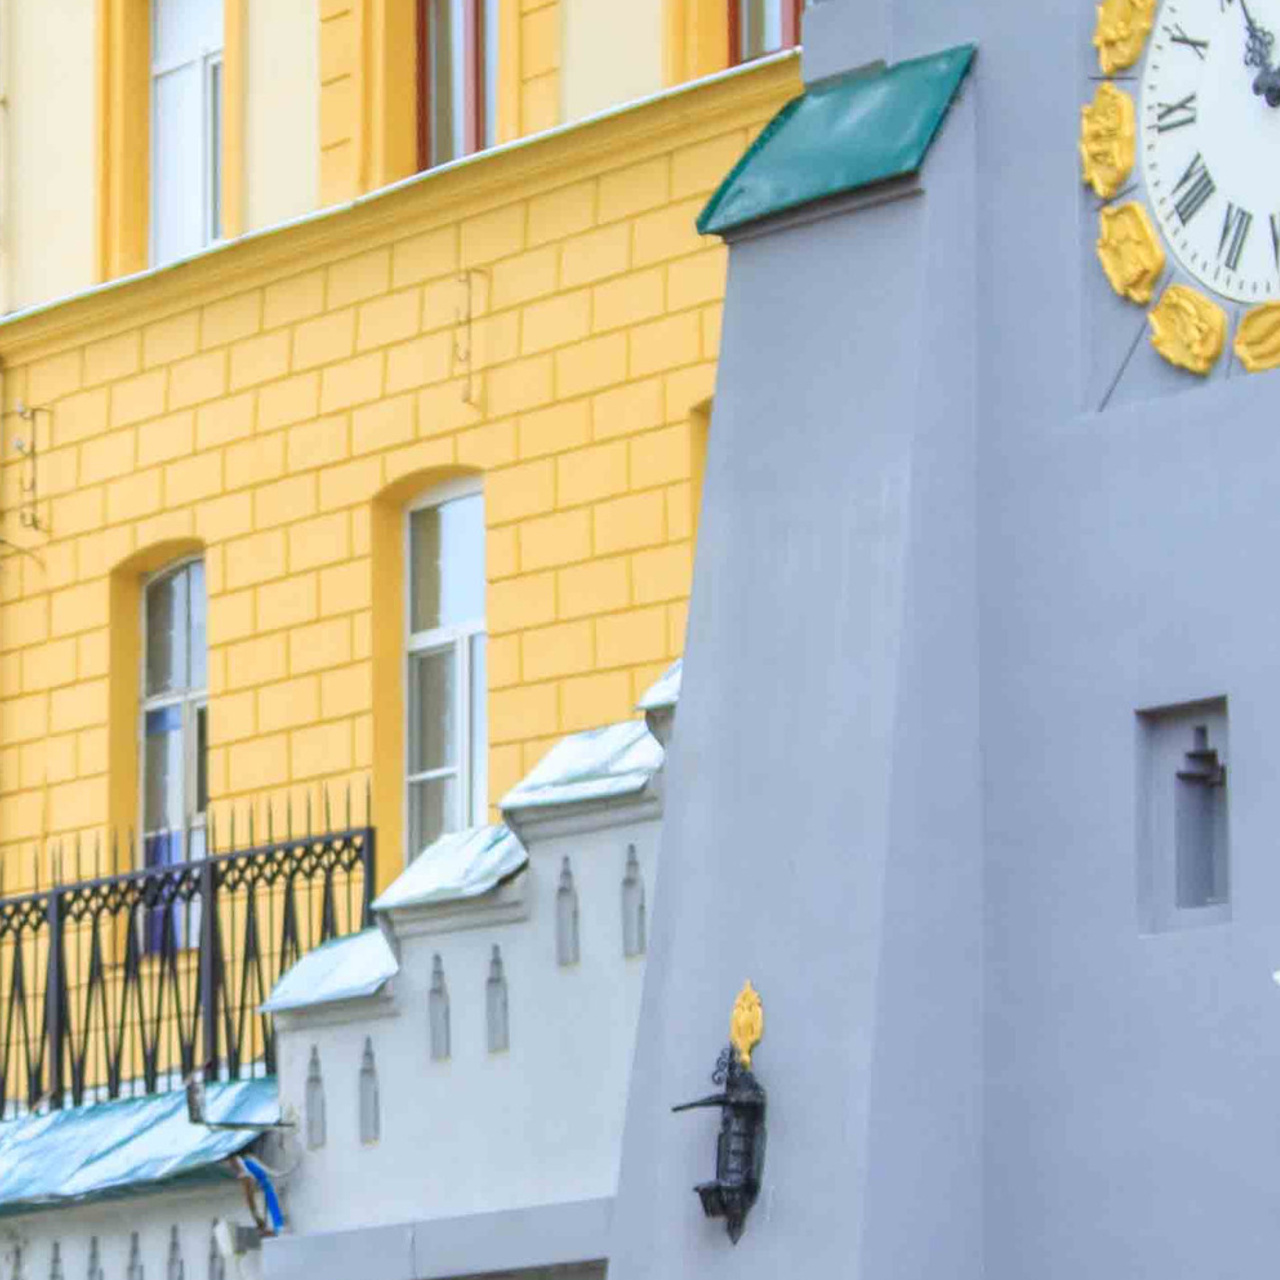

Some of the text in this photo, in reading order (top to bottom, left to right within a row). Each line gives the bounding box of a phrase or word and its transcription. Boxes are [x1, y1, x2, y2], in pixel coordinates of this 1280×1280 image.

[1170, 23, 1208, 60] X
[1157, 94, 1197, 133] IX
[1170, 151, 1216, 227] VIII
[1217, 202, 1253, 271] VII
